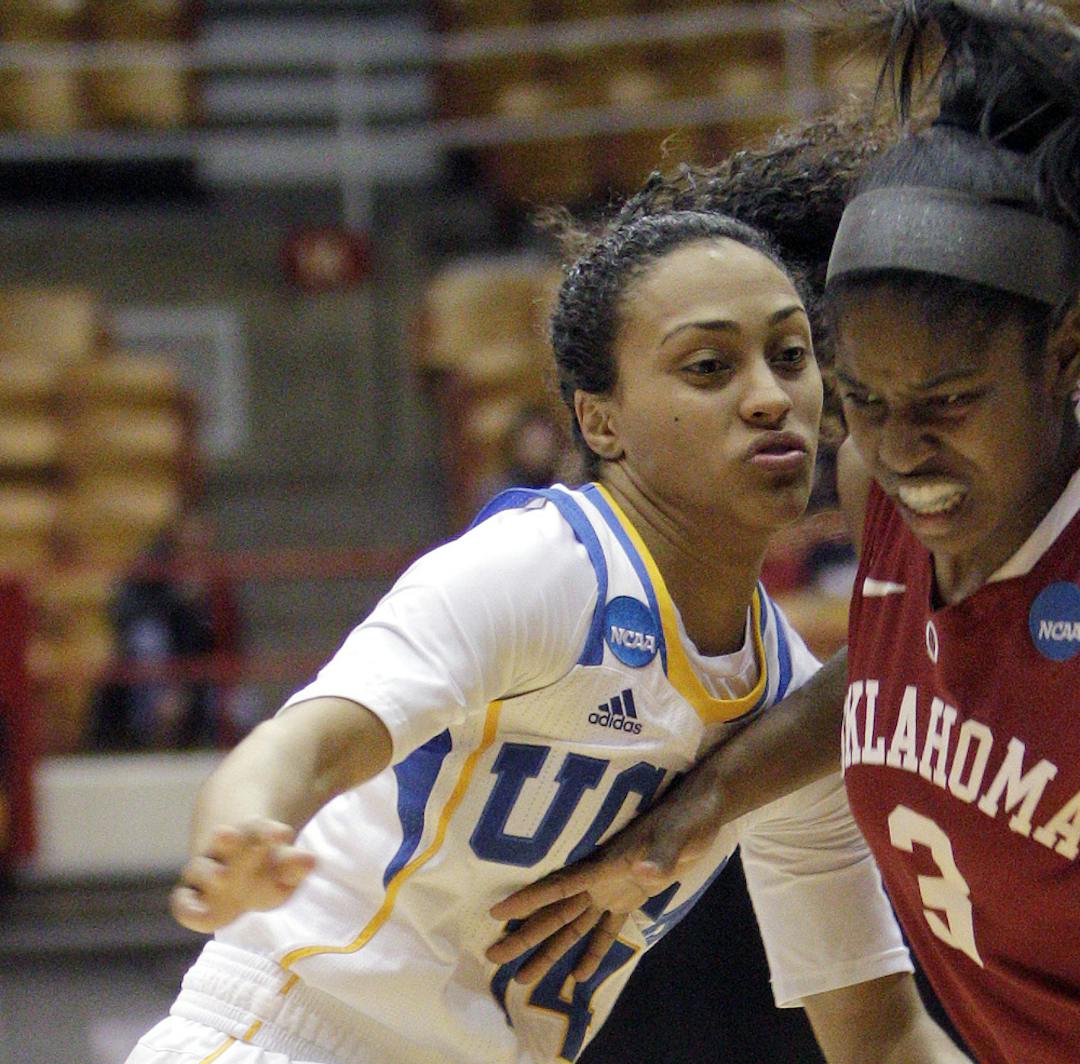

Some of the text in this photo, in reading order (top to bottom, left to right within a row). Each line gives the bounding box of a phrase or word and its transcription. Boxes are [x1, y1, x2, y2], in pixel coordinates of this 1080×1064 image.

[611, 626, 656, 653] NCAA
[588, 711, 642, 735] adidas
[888, 804, 984, 968] 3
